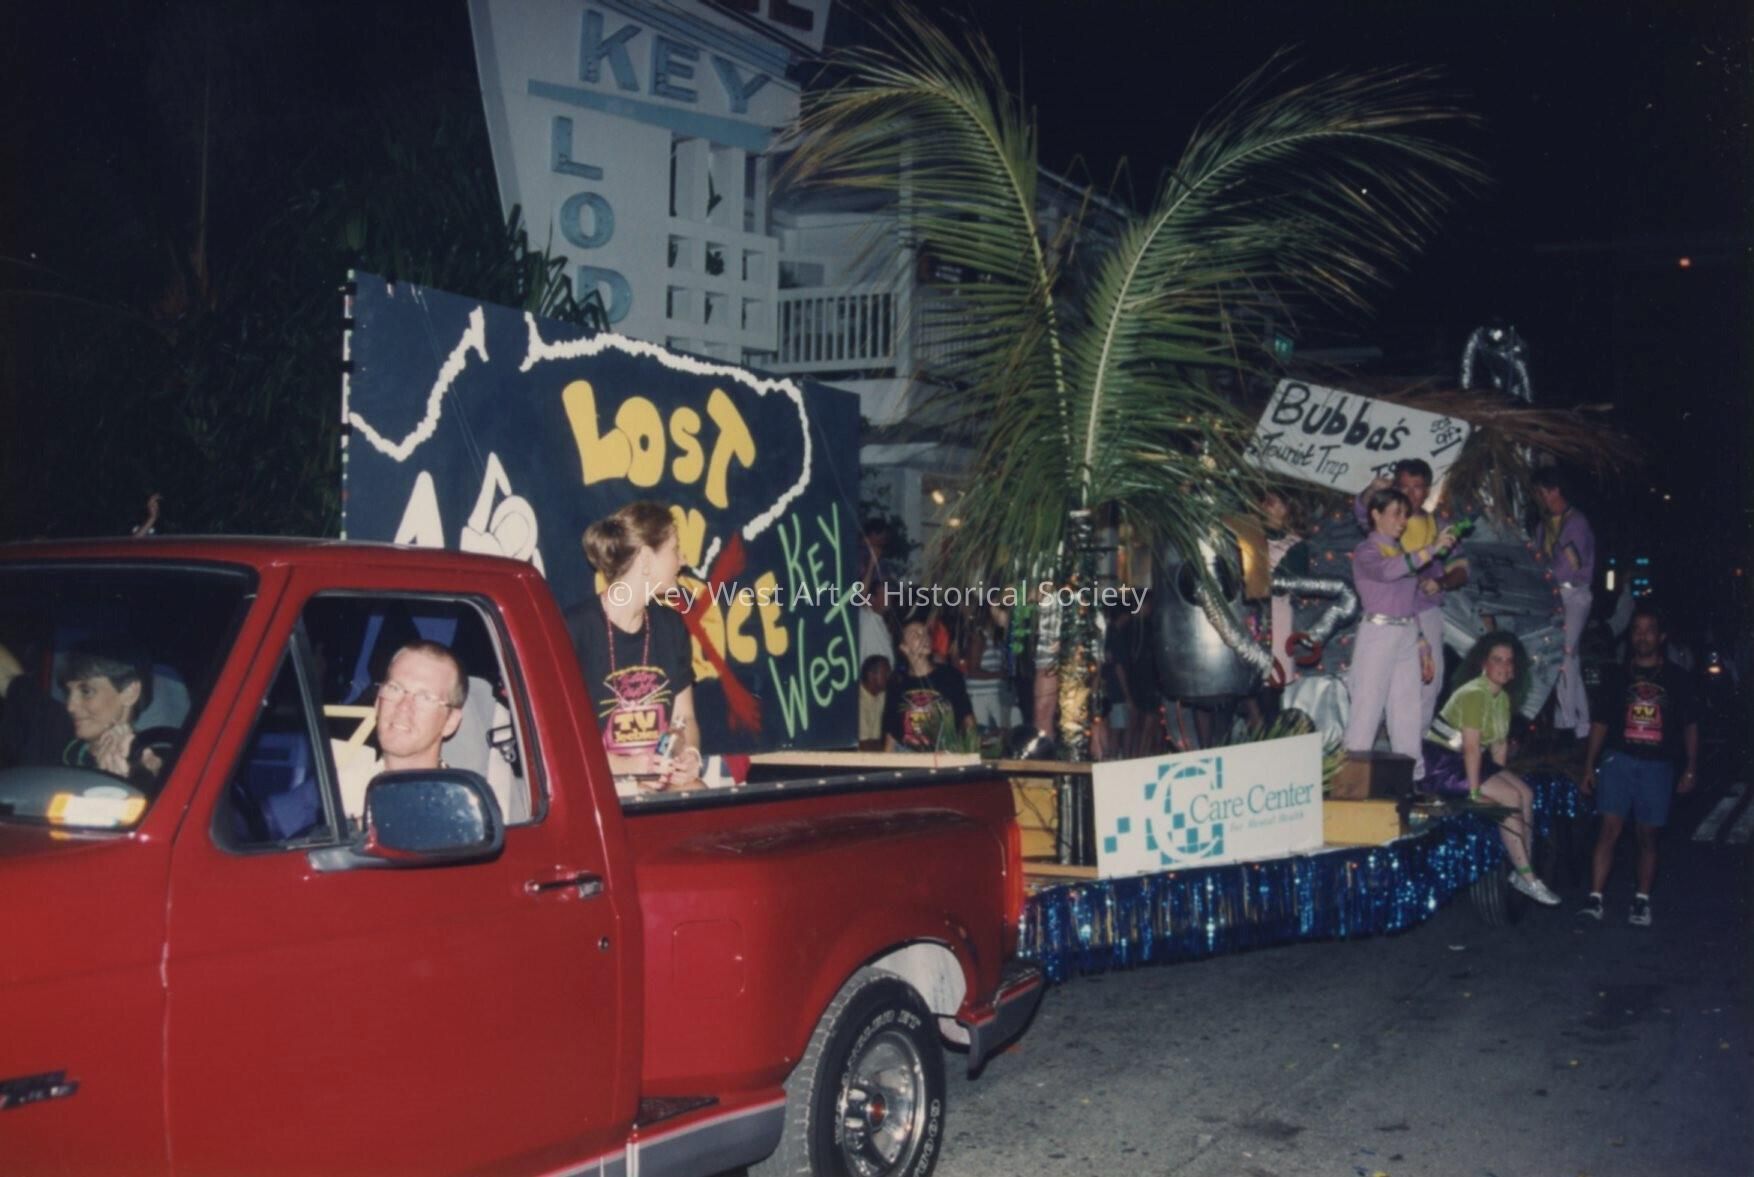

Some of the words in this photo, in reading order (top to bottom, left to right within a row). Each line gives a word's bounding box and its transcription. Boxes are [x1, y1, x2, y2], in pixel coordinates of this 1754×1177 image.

[578, 9, 773, 114] KEY
[562, 380, 756, 508] LOST
[1270, 382, 1411, 451] Bubba's
[614, 711, 657, 732] TV
[1189, 793, 1244, 824] Care
[1246, 782, 1315, 814] Center
